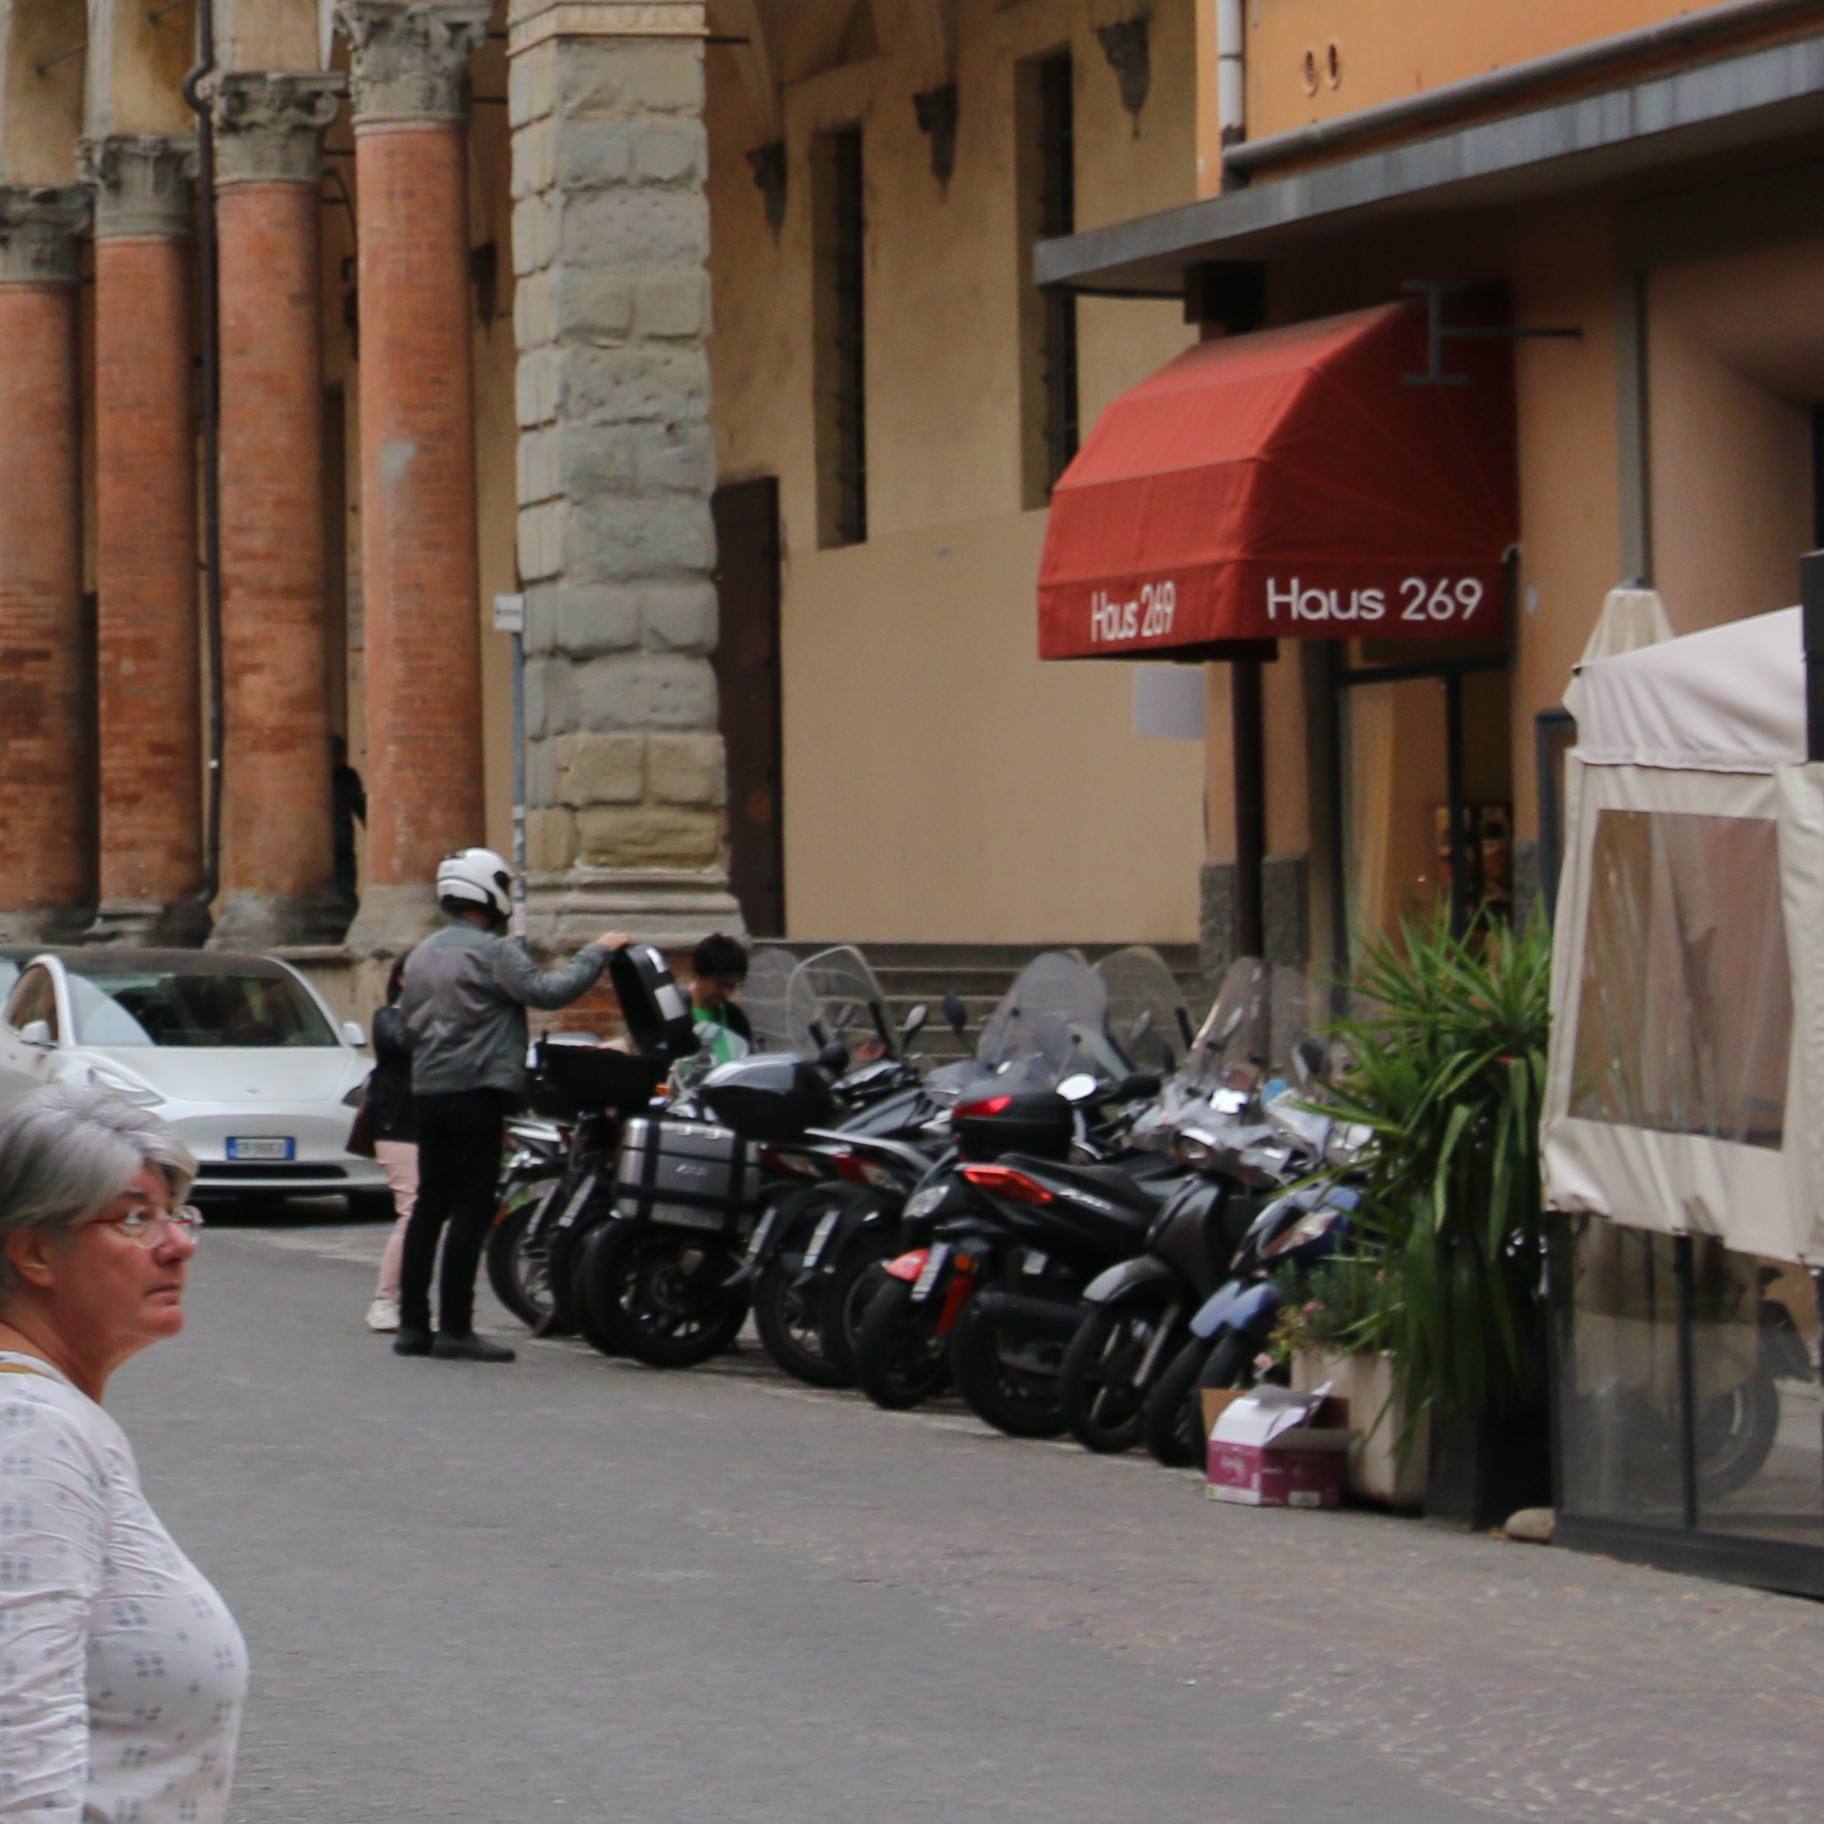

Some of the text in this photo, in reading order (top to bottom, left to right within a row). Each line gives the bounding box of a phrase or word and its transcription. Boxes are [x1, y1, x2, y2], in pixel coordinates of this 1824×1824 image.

[1090, 579, 1176, 642] Haus 269
[1266, 577, 1484, 621] Haus 269
